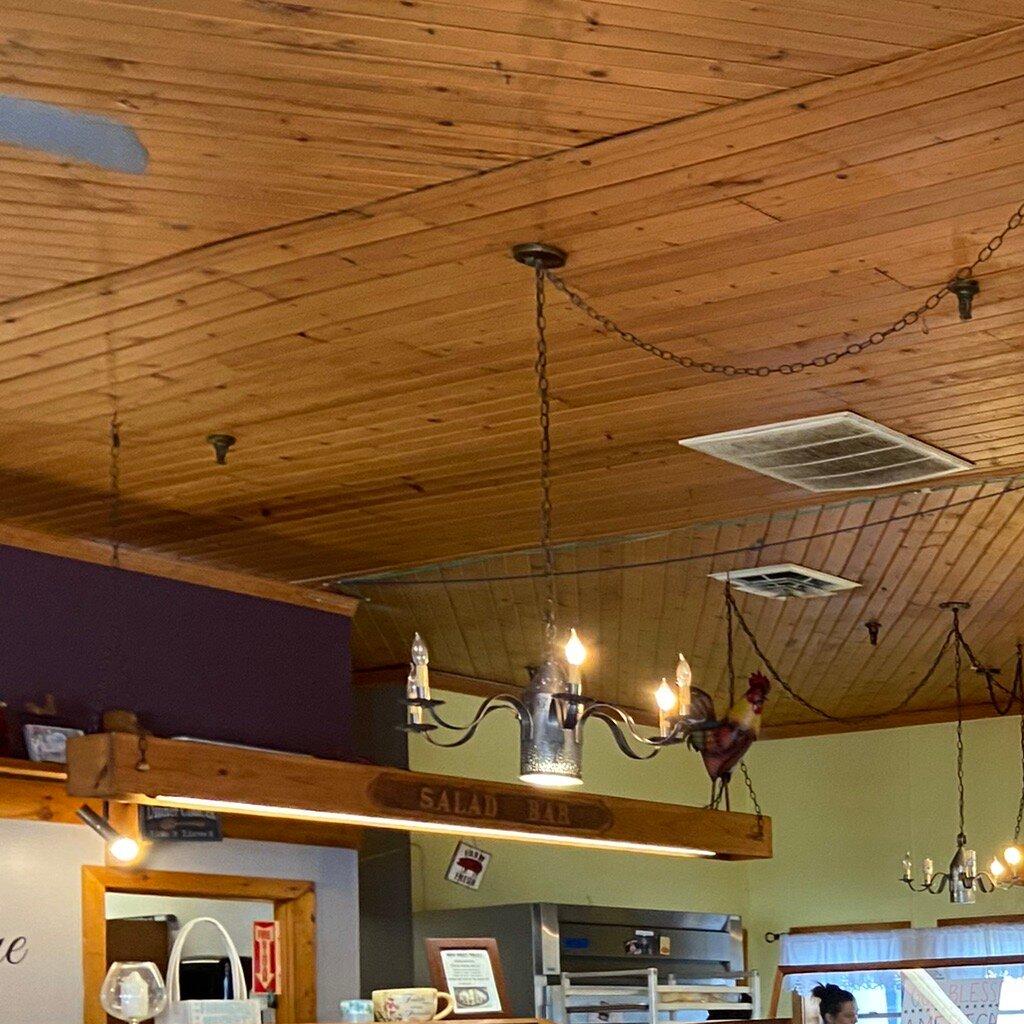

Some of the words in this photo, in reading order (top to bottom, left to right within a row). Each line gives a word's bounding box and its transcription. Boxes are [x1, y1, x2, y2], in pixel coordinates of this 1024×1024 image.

[421, 787, 498, 818] SALAD
[529, 800, 570, 825] BAR
[949, 982, 997, 1003] BLESS
